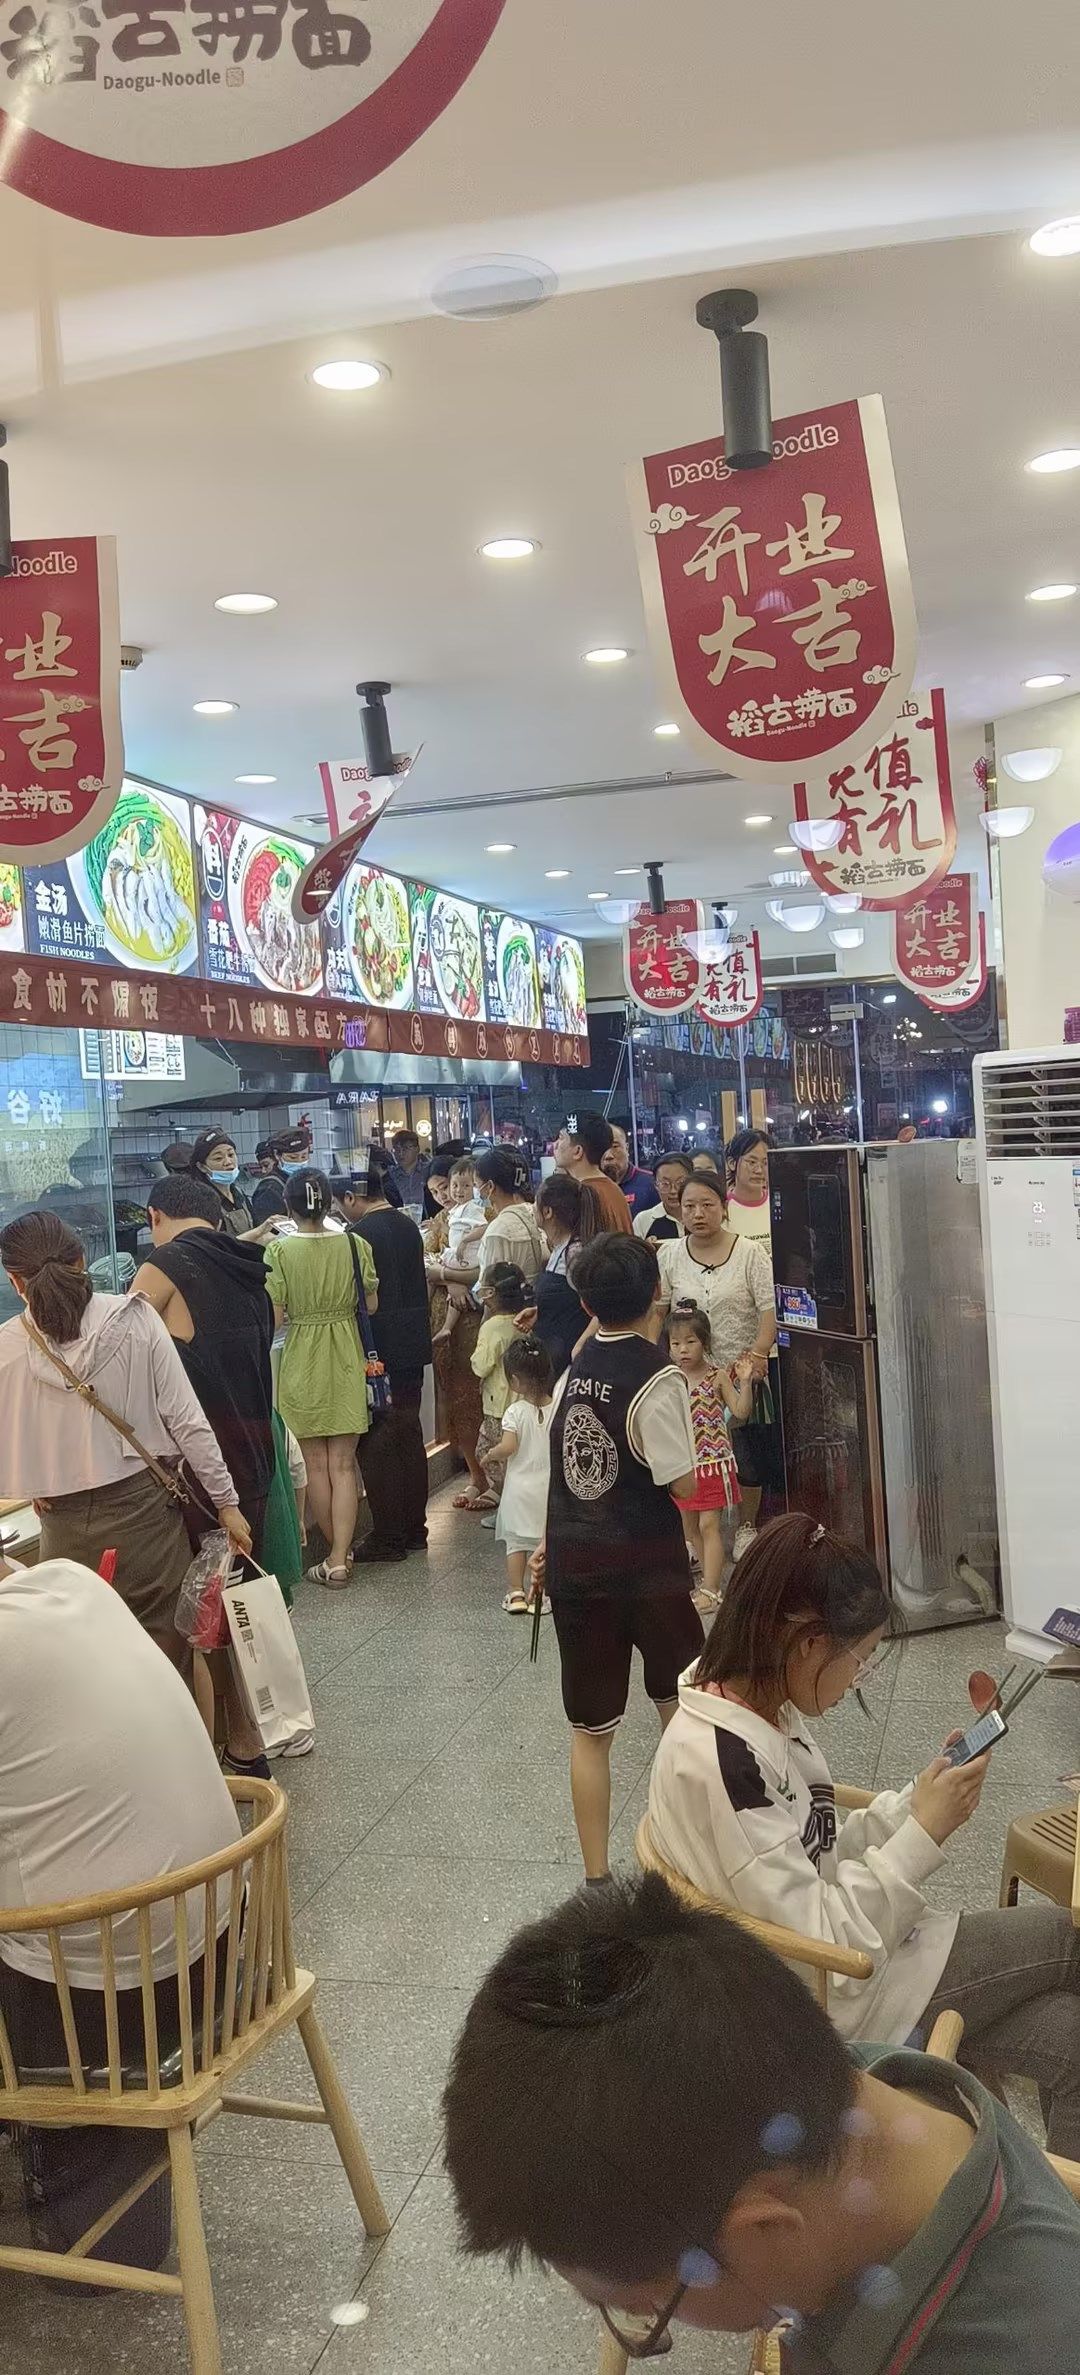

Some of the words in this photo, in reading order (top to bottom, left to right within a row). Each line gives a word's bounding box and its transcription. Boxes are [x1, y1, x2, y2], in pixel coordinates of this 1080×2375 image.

[103, 68, 221, 91] Daogu-Noodle
[668, 424, 839, 489] Daogoodle
[683, 493, 855, 596] 开业
[0, 611, 78, 680] 业
[699, 578, 863, 686] 大吉
[727, 686, 857, 738] 稻古捞面
[0, 688, 77, 772] 吉
[840, 858, 926, 885] 稻古捞面
[35, 880, 67, 916] 金汤
[904, 900, 962, 931] 开业
[40, 944, 60, 956] FISH
[60, 946, 95, 960] NOODLES
[637, 924, 688, 955] 开业
[905, 929, 964, 960] 大吉
[638, 953, 692, 982] 大吉
[701, 974, 756, 1002] 有礼
[232, 1600, 251, 1629] ANTA
